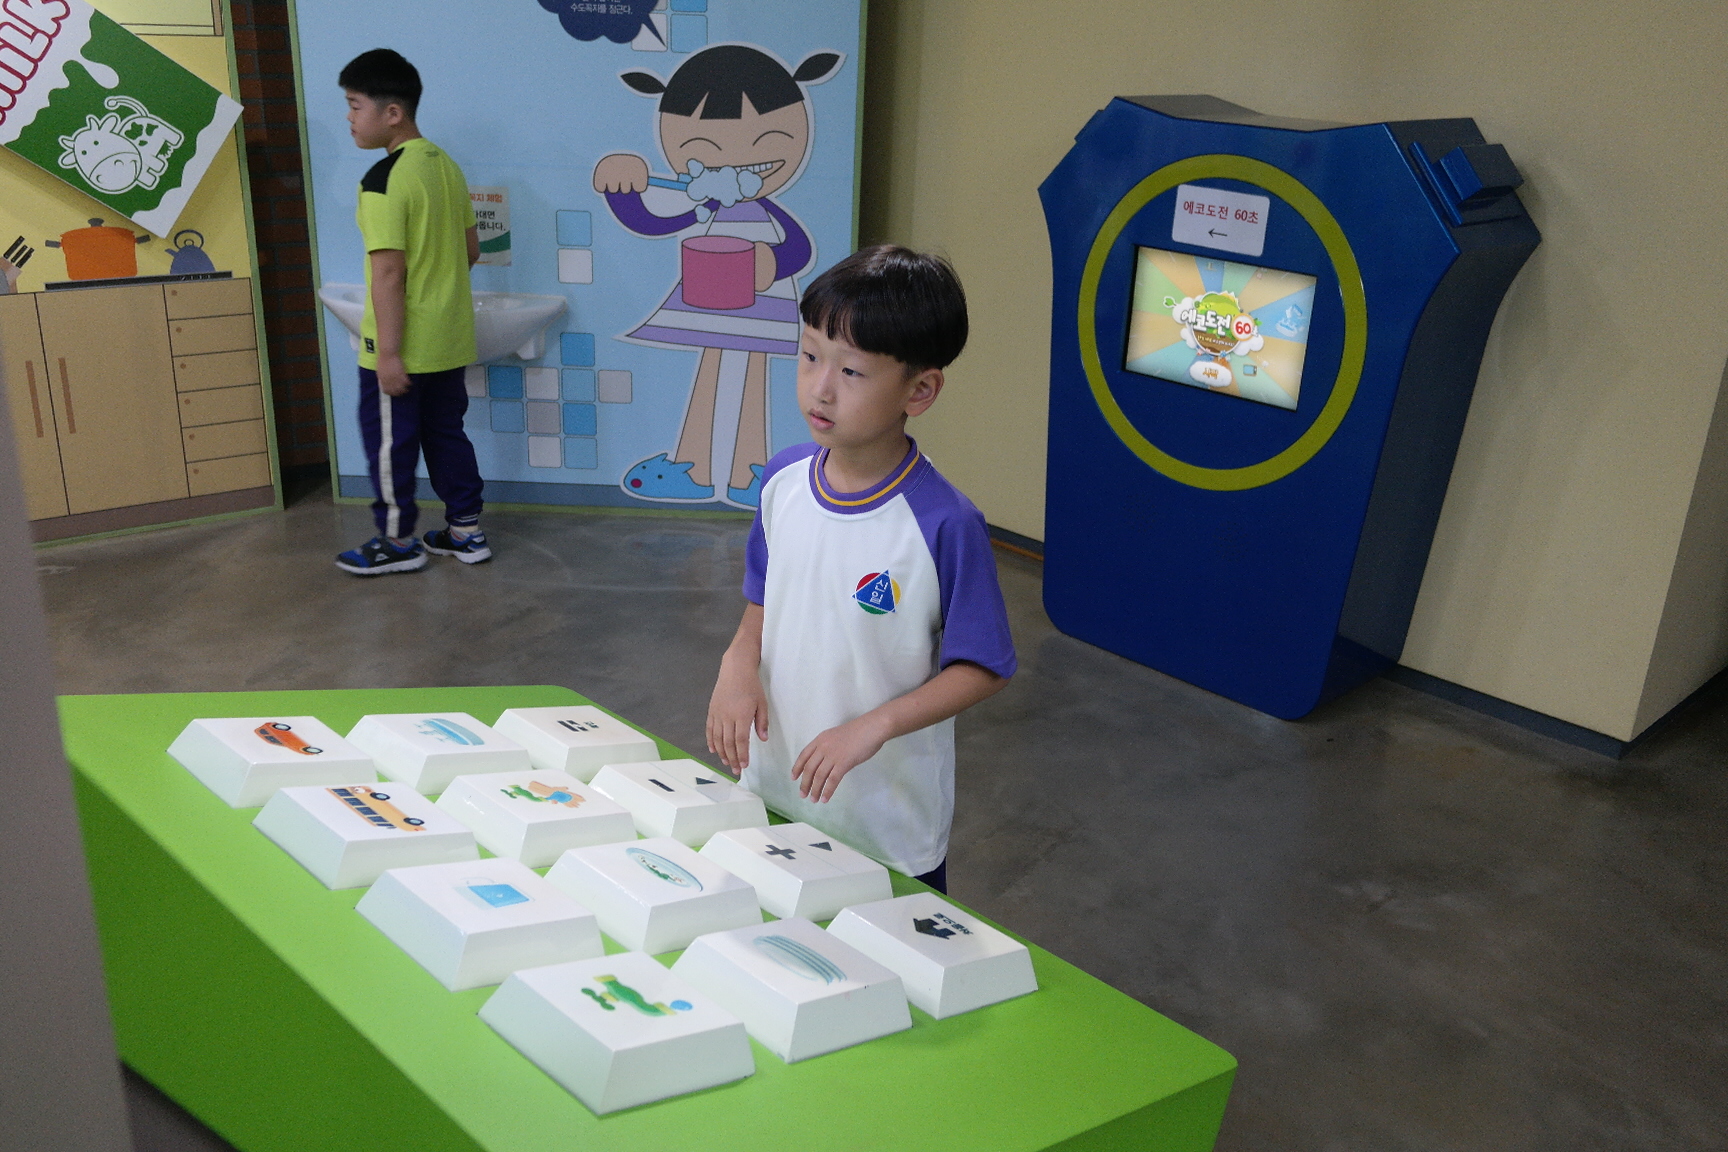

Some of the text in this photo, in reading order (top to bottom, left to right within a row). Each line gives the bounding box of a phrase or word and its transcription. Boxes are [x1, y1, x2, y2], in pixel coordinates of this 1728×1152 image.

[1183, 201, 1259, 224] 에코도전 60초
[476, 221, 506, 231] 옵니다.
[1180, 309, 1231, 337] 에코도전
